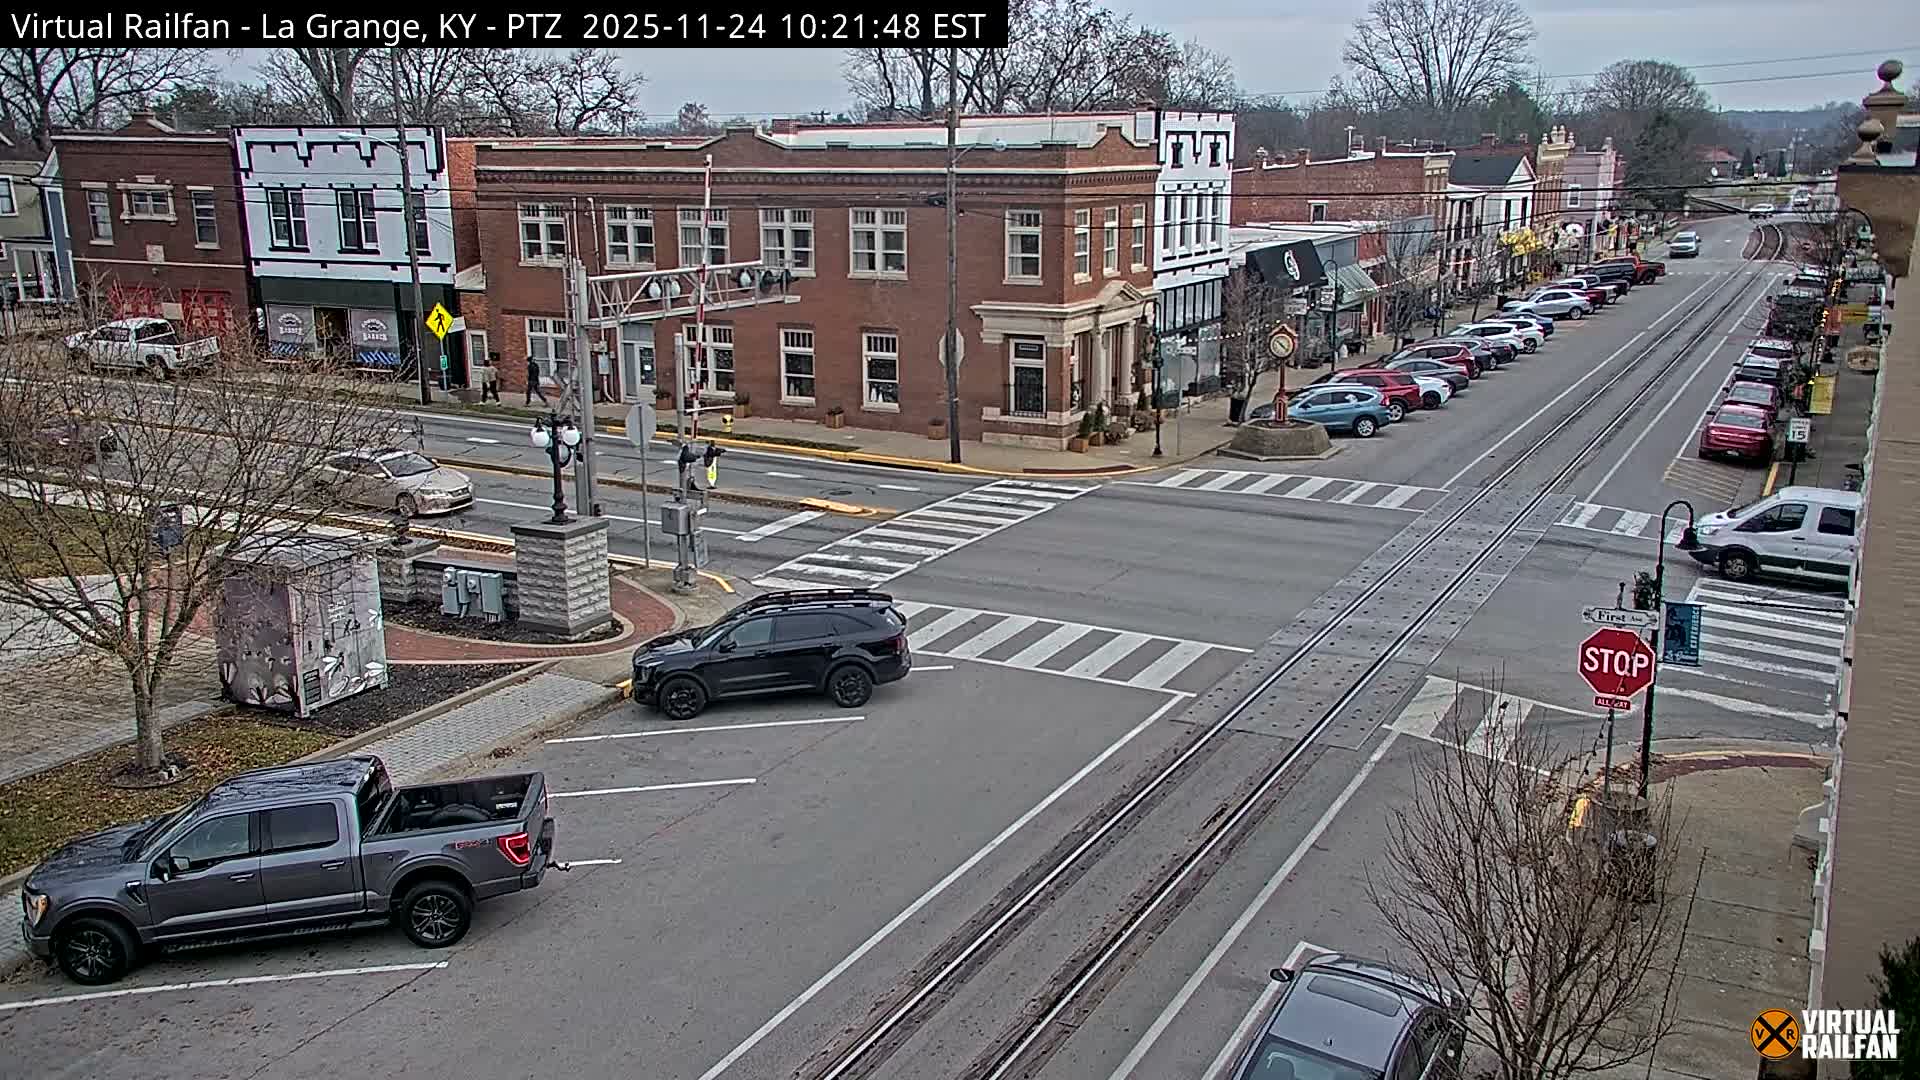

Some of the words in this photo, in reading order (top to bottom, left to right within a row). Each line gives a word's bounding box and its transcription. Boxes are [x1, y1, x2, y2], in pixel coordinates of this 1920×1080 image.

[1791, 430, 1806, 440] 15
[1598, 610, 1626, 622] First
[1584, 647, 1649, 677] STOP
